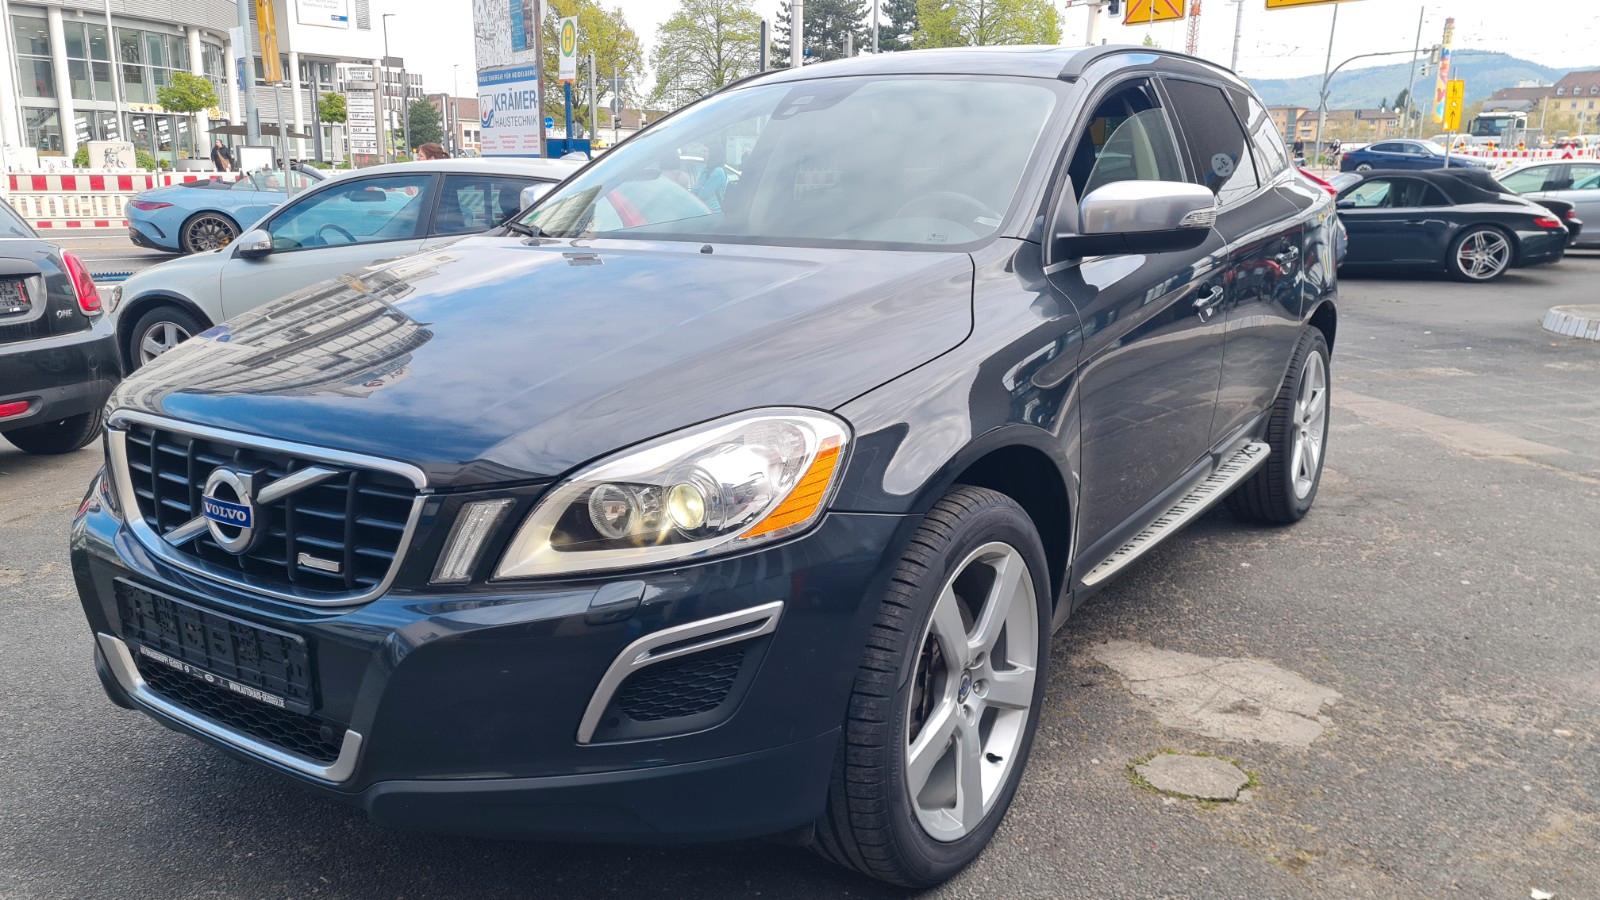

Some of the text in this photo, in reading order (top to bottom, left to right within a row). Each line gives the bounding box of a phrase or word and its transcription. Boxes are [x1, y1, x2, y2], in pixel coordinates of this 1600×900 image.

[564, 27, 571, 49] H
[494, 115, 538, 128] HAUSTECHNIK
[203, 501, 247, 522] VOLVO
